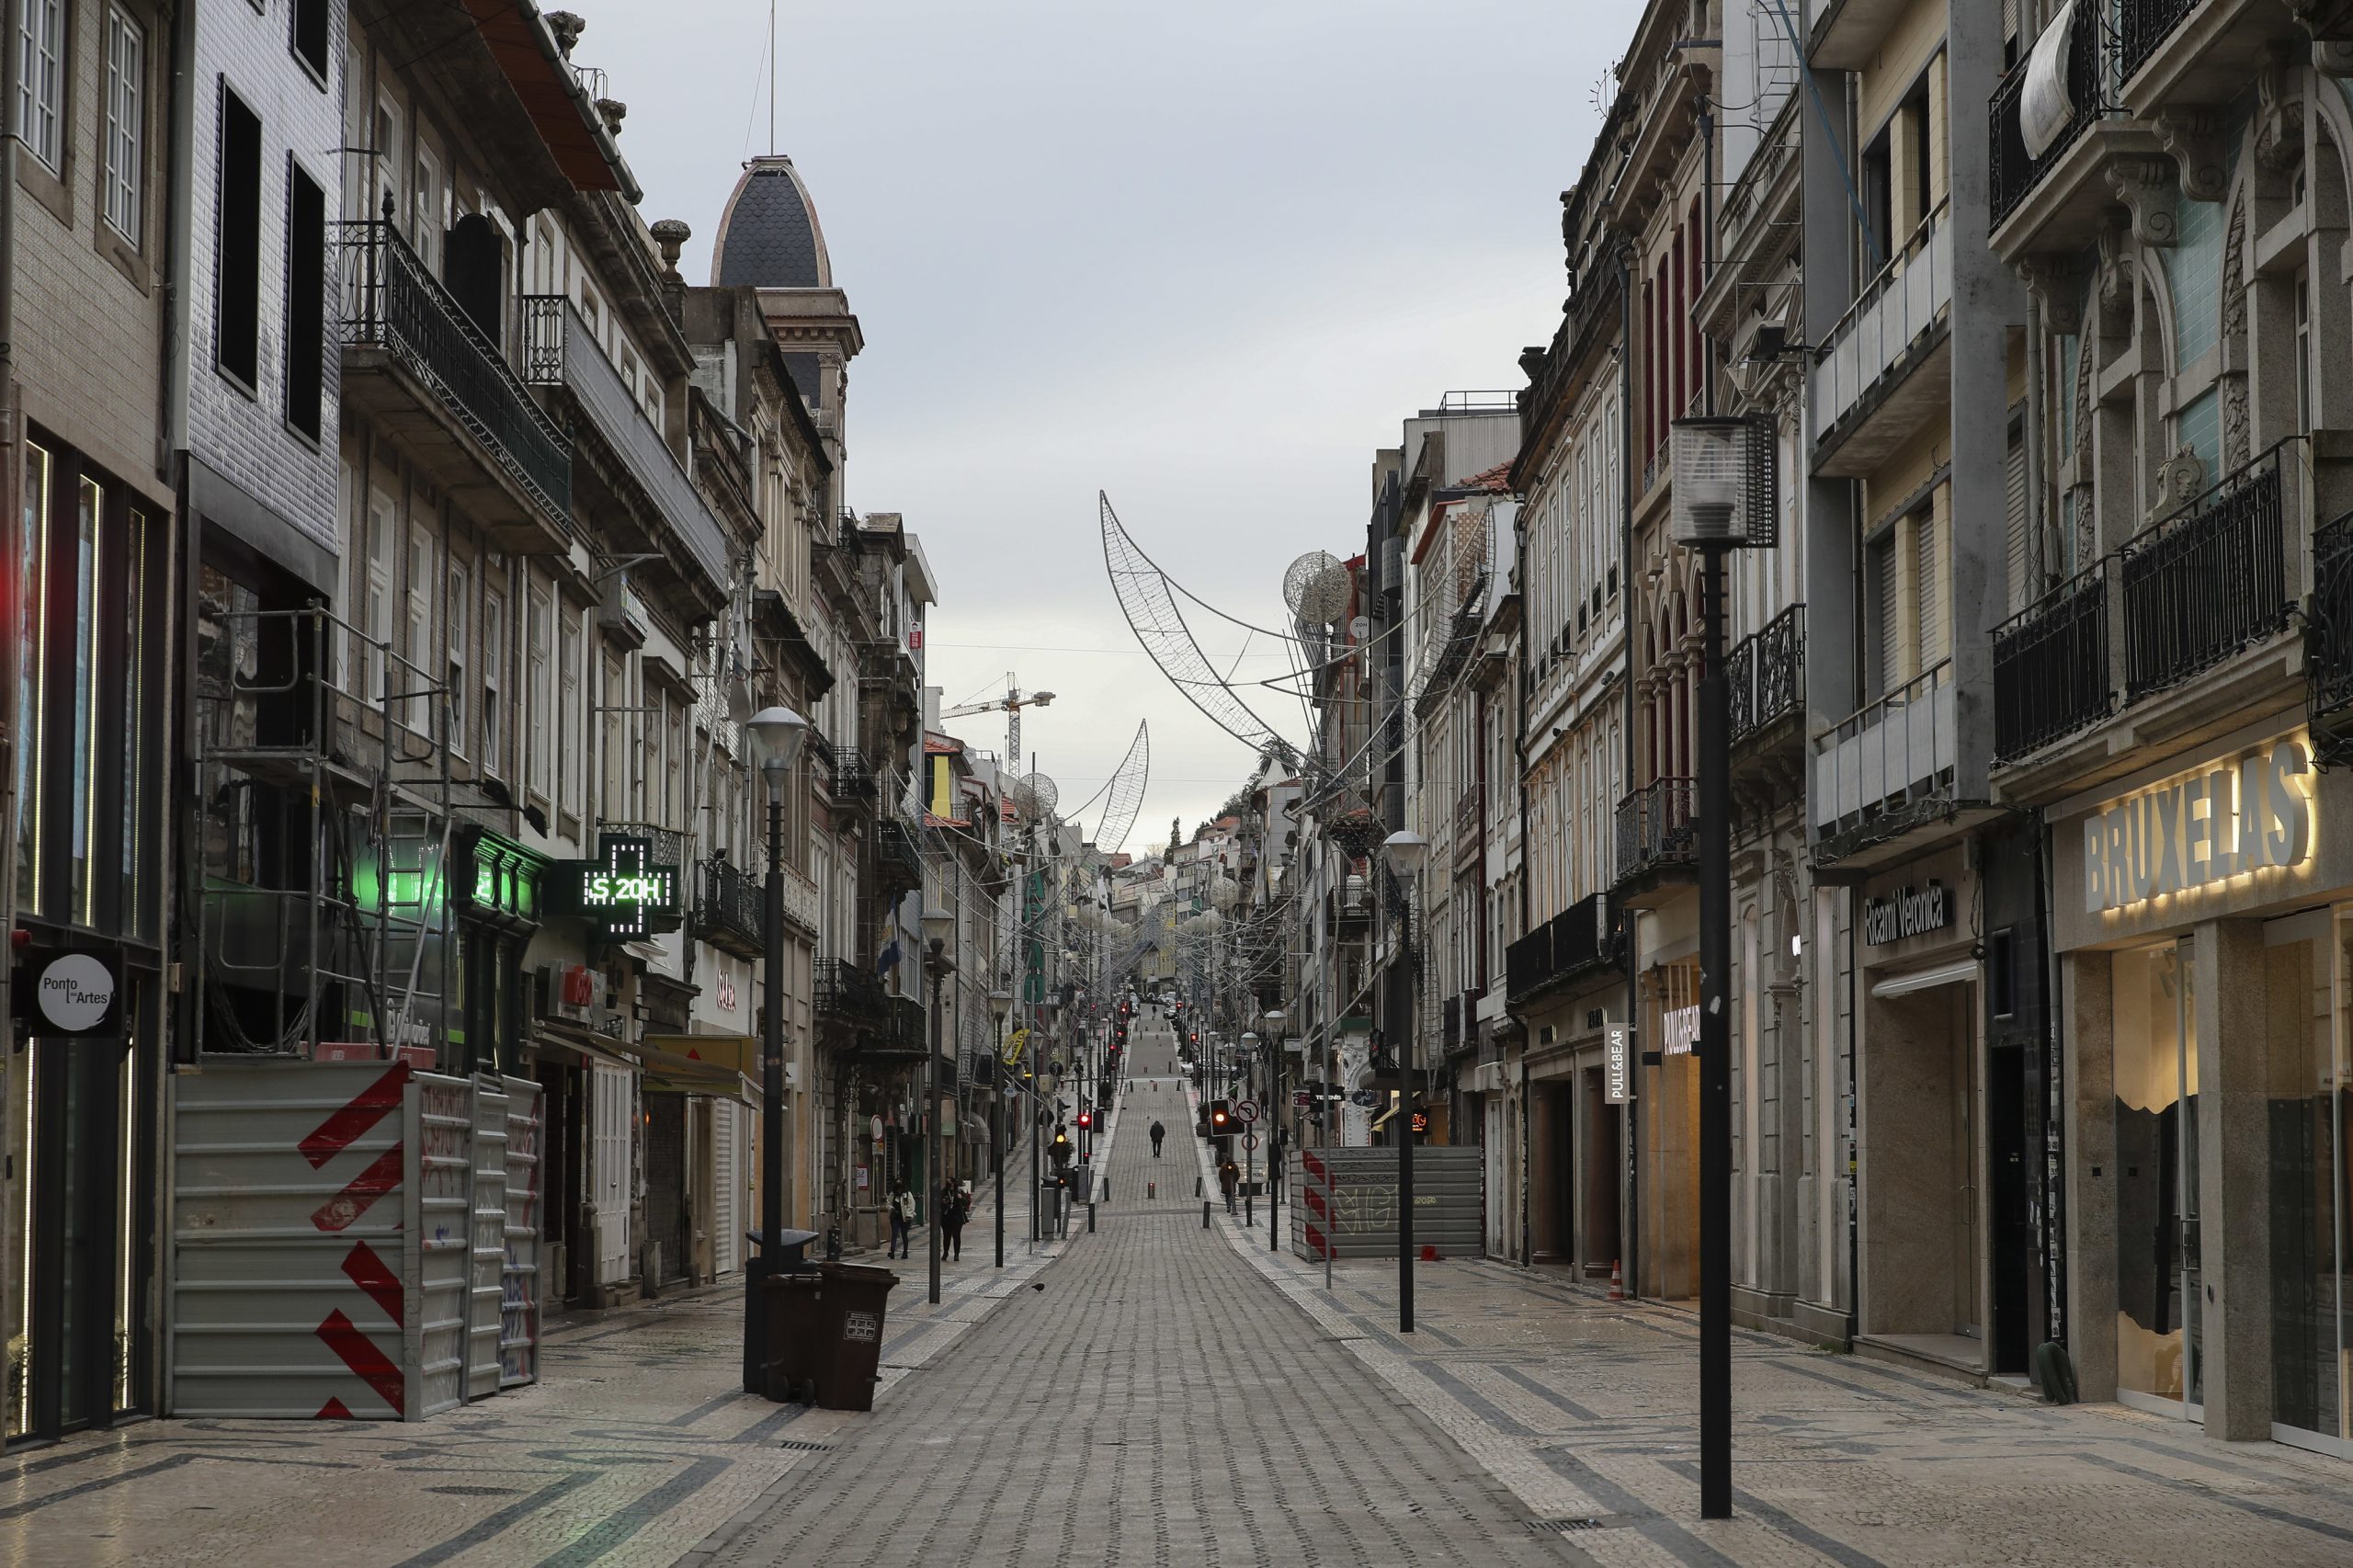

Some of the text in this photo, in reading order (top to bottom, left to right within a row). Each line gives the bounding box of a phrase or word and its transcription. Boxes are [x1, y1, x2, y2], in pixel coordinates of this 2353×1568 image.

[2084, 741, 2309, 915] BRUXELAS
[588, 878, 659, 900] S 20H
[1865, 878, 1944, 947] Ricami Veronica
[76, 992, 108, 1004] Artes
[1611, 1029, 1623, 1098] PULL&BEAR
